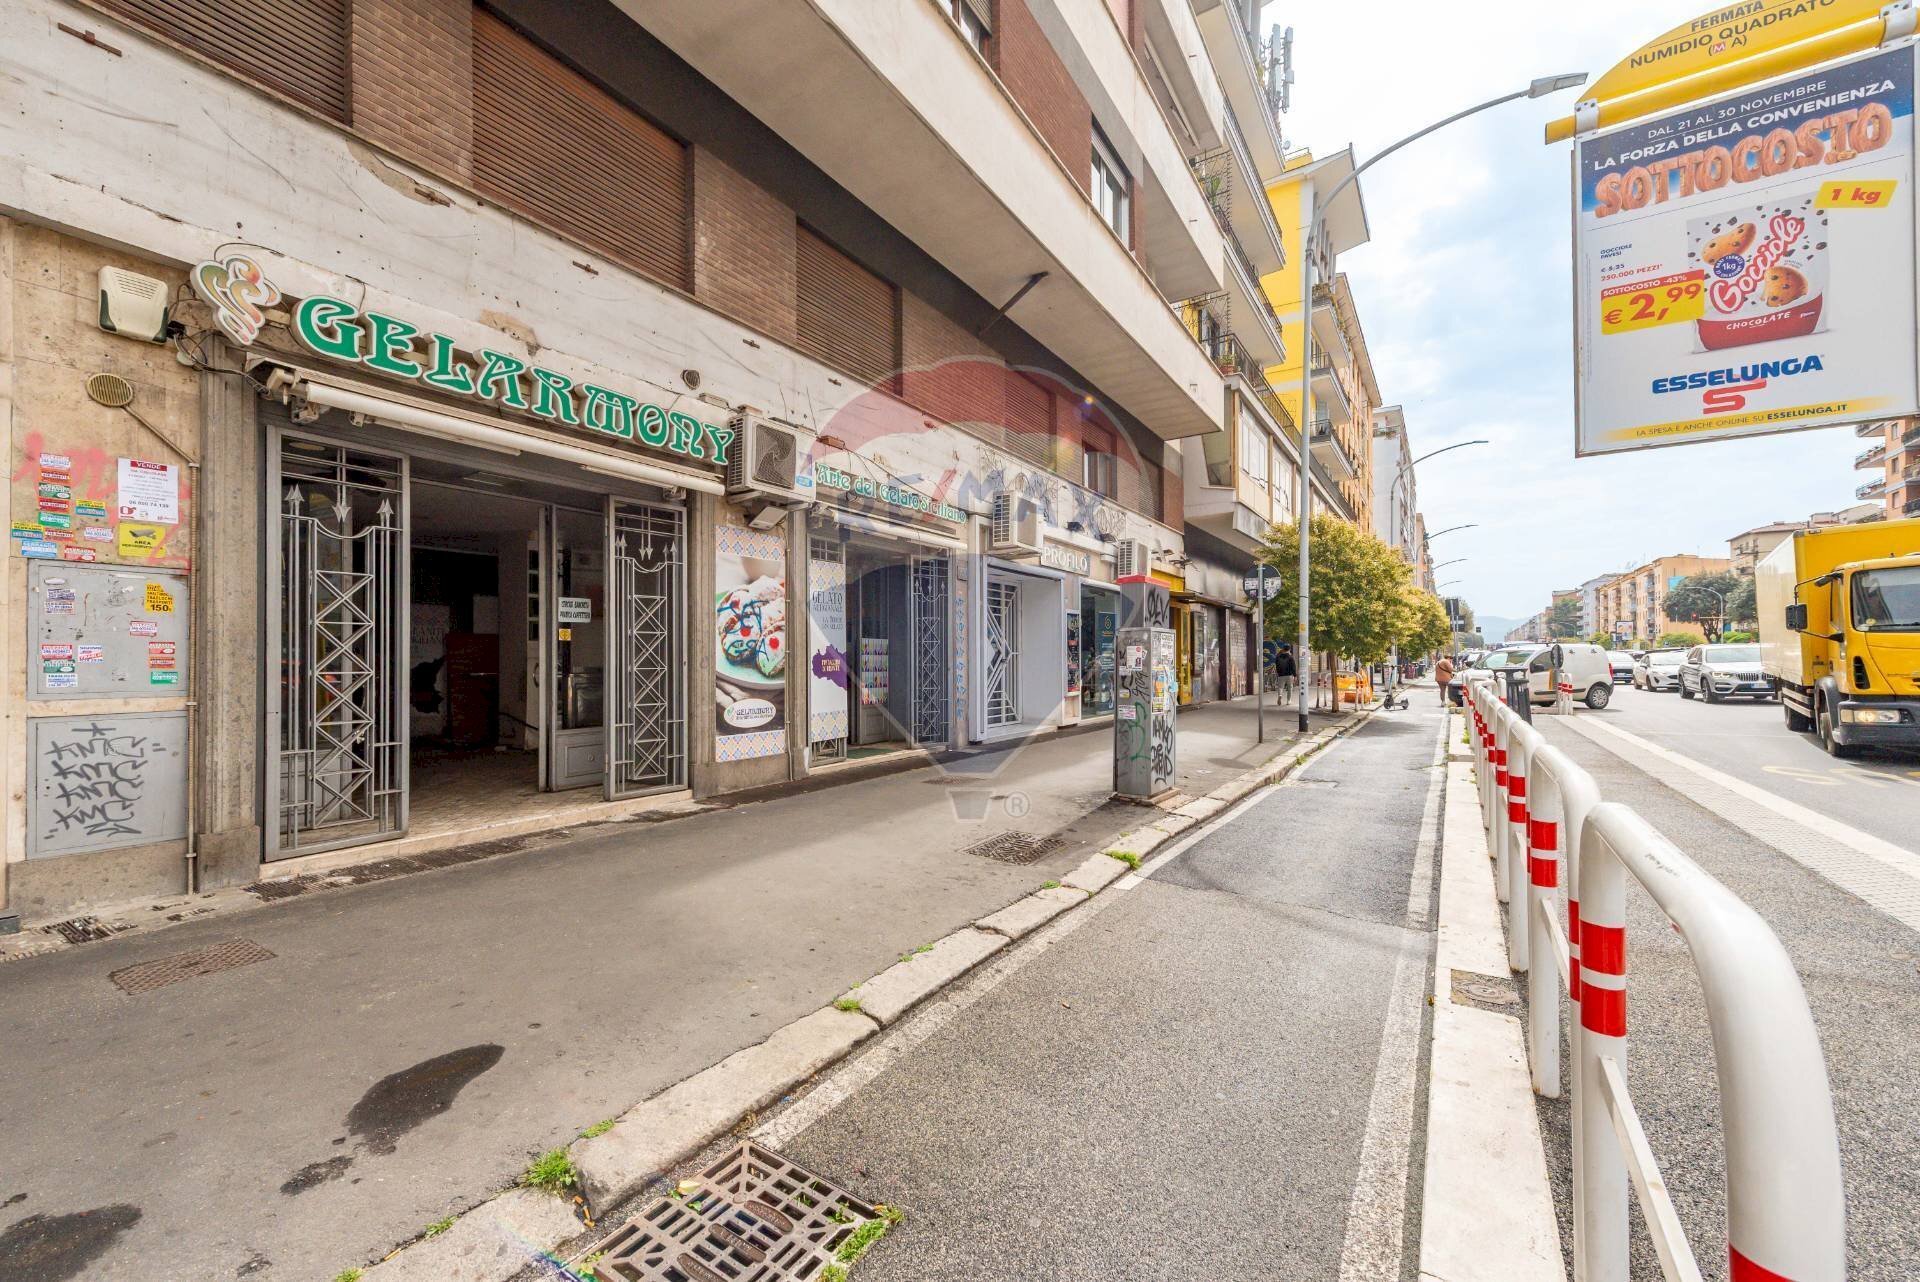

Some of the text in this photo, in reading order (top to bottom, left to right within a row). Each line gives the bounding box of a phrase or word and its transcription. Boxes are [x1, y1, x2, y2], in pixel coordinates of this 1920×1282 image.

[1691, 0, 1764, 32] FERMATA
[1630, 34, 1713, 69] NUMIDIO
[1594, 79, 1896, 171] LA FORZA DELLA CONVENIENZA
[1648, 80, 1827, 139] DAL 21 AL 30 NOVEMBRE
[1594, 102, 1893, 219] SOTTOCOSTO
[1831, 187, 1882, 204] 1 kg
[1600, 269, 1634, 281] 250.000
[1603, 274, 1688, 297] SOTTOCOSTO -43%
[1604, 283, 1702, 325] € 2,99
[1726, 311, 1791, 330] CHOCOLATE
[294, 295, 735, 465] GELARMONY
[1652, 355, 1824, 394] ESSELUNGA
[1648, 427, 1673, 435] SPESA
[1683, 421, 1713, 432] ANCHE
[1767, 404, 1848, 420] ESSELUNGA.IT
[854, 477, 877, 498] del
[880, 484, 920, 510] Gelato
[920, 496, 967, 524] Siciliano
[1043, 545, 1089, 572] PROFILO
[812, 590, 843, 605] GELATO
